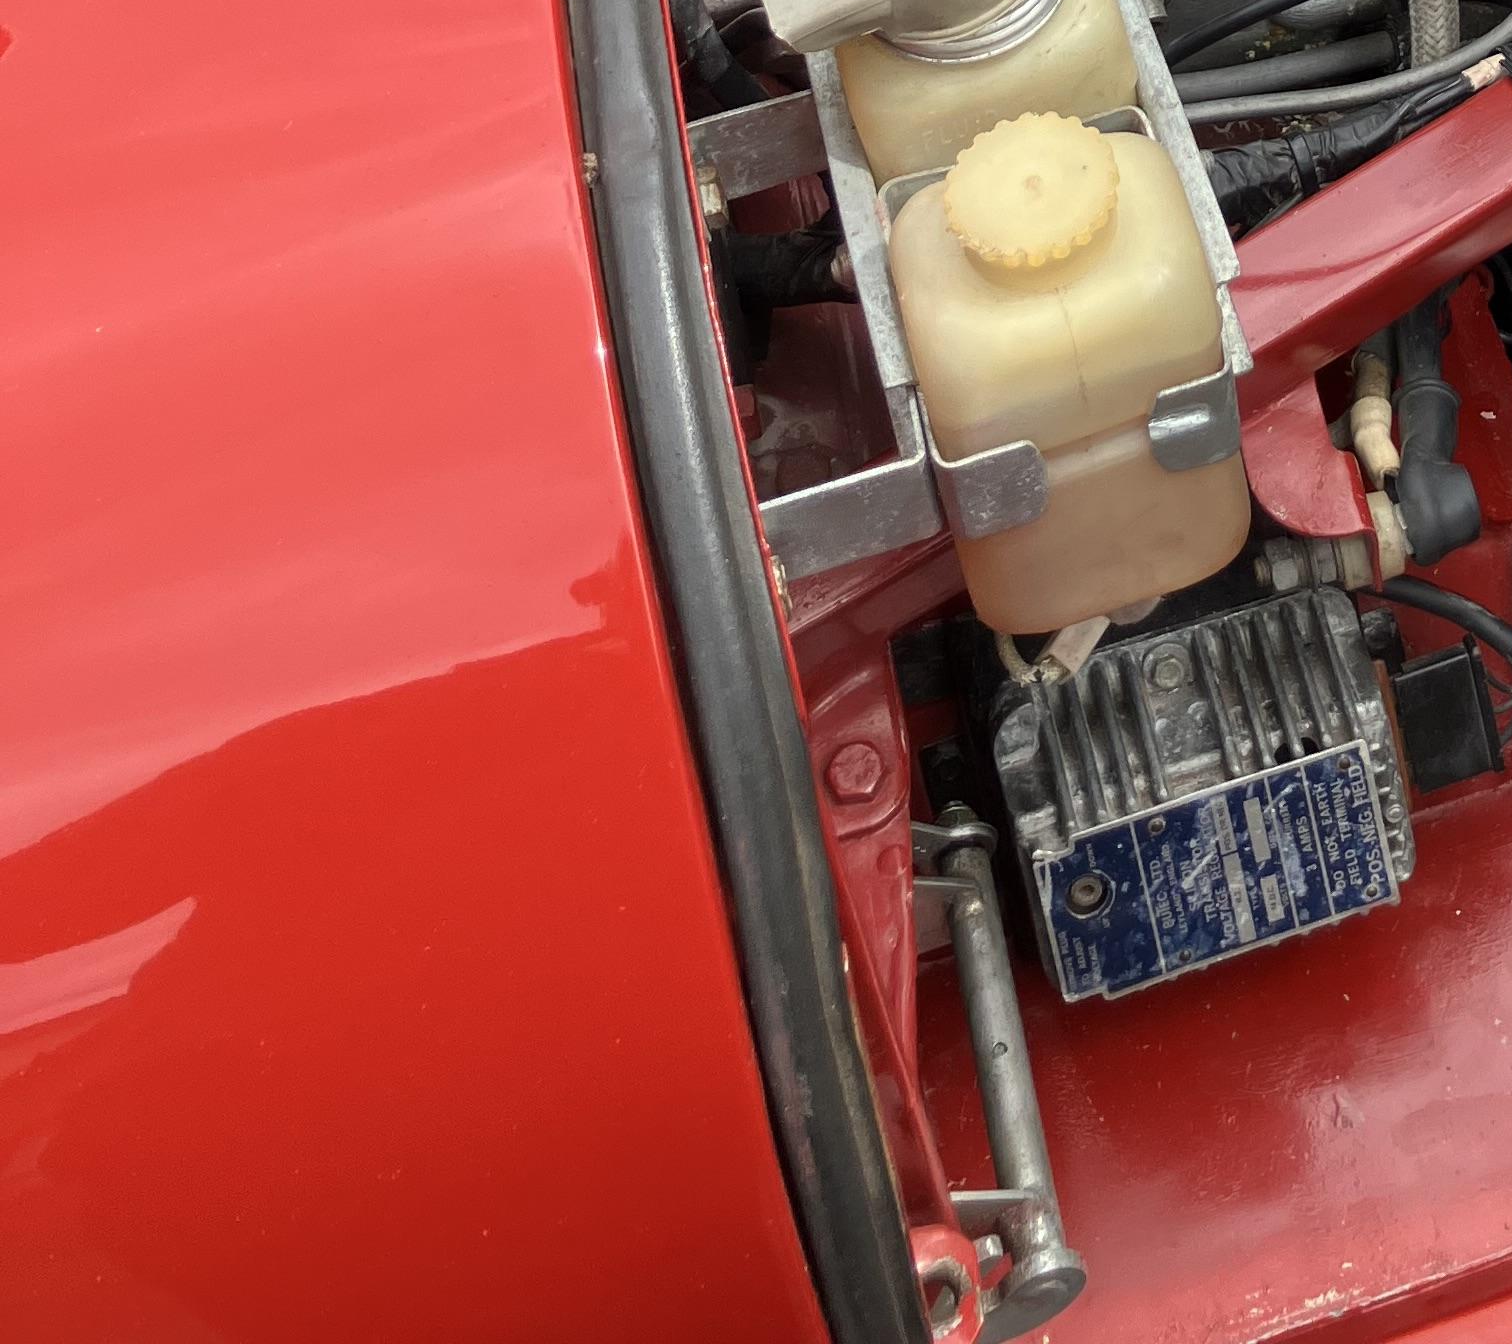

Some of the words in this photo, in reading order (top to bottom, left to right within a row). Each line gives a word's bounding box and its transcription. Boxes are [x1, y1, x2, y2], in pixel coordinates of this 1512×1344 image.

[1314, 781, 1334, 827] EARTH
[1347, 763, 1370, 808] FIELD
[1331, 778, 1355, 842] TERMINAL
[1296, 815, 1314, 855] AMPS
[1324, 833, 1342, 863] NOT
[1305, 861, 1319, 873] 3
[1332, 868, 1348, 892] DO
[1345, 848, 1363, 887] FIELD
[1216, 886, 1237, 942] VOLTAGE
